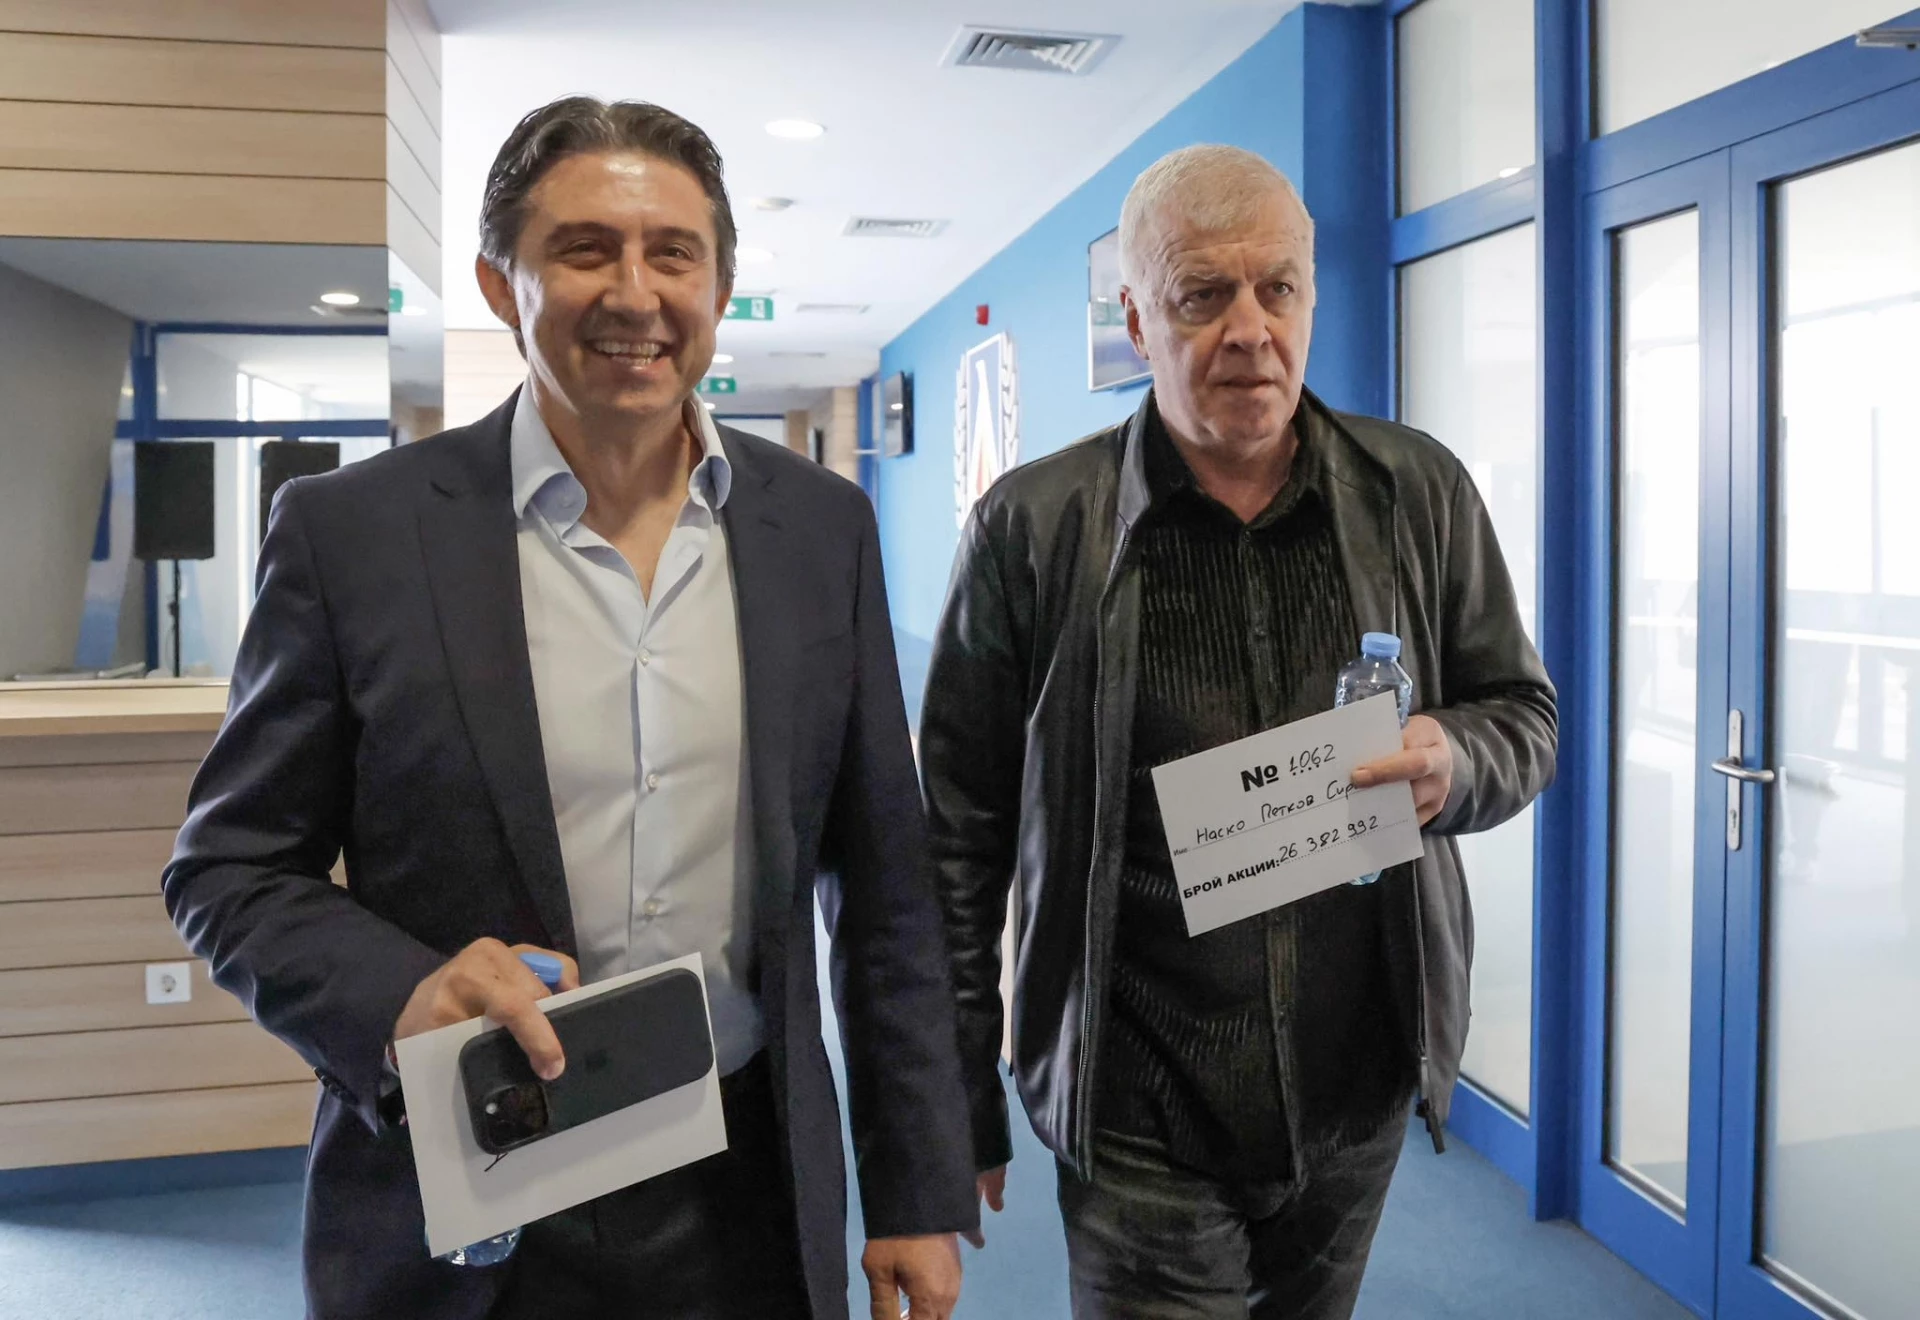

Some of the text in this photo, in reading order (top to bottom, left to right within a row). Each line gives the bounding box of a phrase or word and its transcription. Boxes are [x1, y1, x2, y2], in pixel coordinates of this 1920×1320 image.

[1289, 744, 1335, 772] 1062
[1197, 820, 1245, 845] Наско
[1260, 795, 1314, 822] Петков
[1327, 779, 1359, 800] Сир
[1183, 877, 1222, 899] БРОЙ
[1227, 859, 1280, 884] АКЦИИ:
